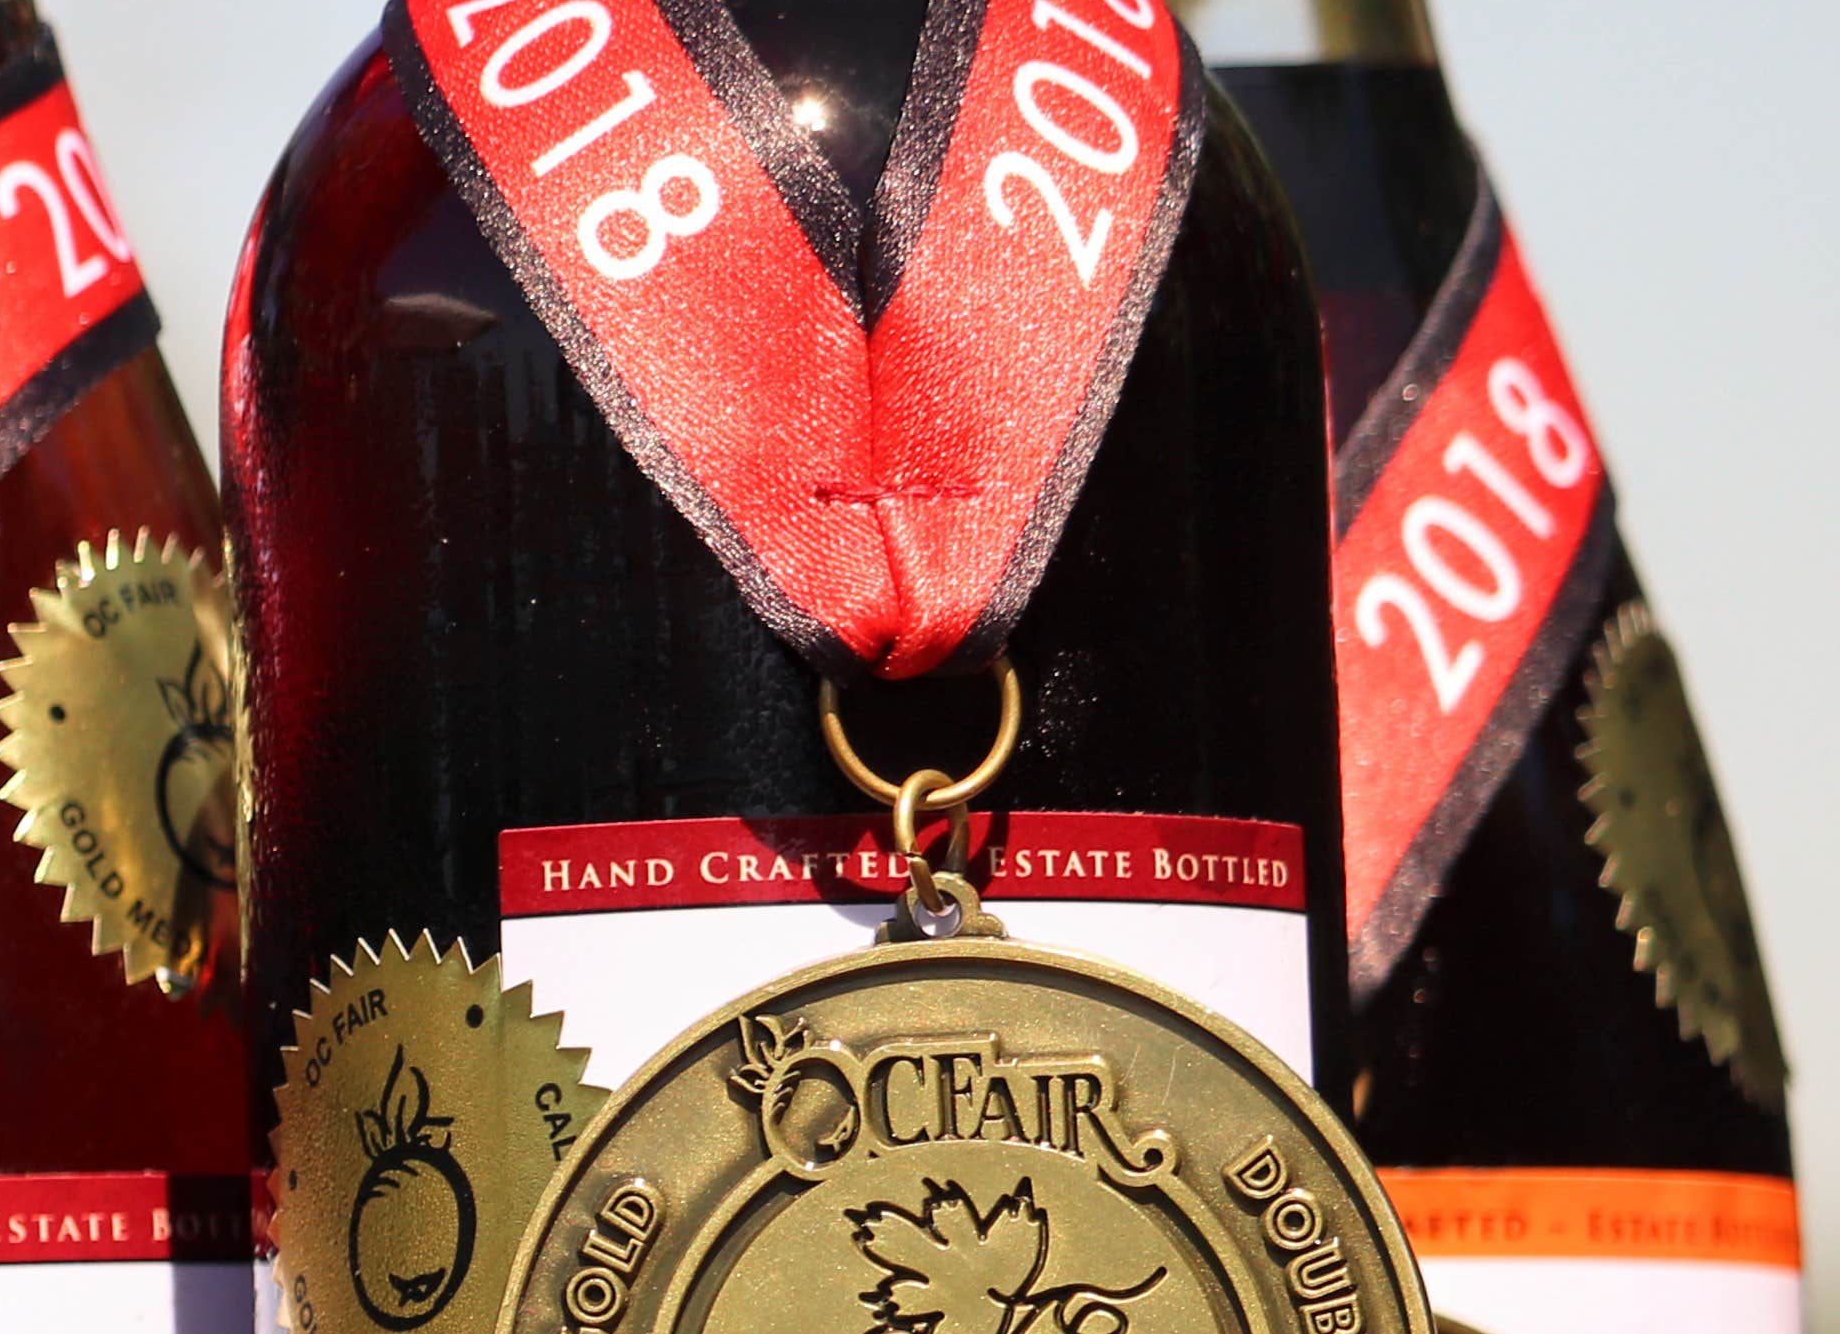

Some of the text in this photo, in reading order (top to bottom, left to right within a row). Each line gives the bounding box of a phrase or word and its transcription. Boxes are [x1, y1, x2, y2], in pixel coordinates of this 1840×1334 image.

[1355, 355, 1589, 715] 2018
[60, 801, 122, 901] GOLD
[541, 845, 1288, 892] HAND CRAFTED ESTATE BOTTLED
[305, 987, 388, 1089] OC FAIR
